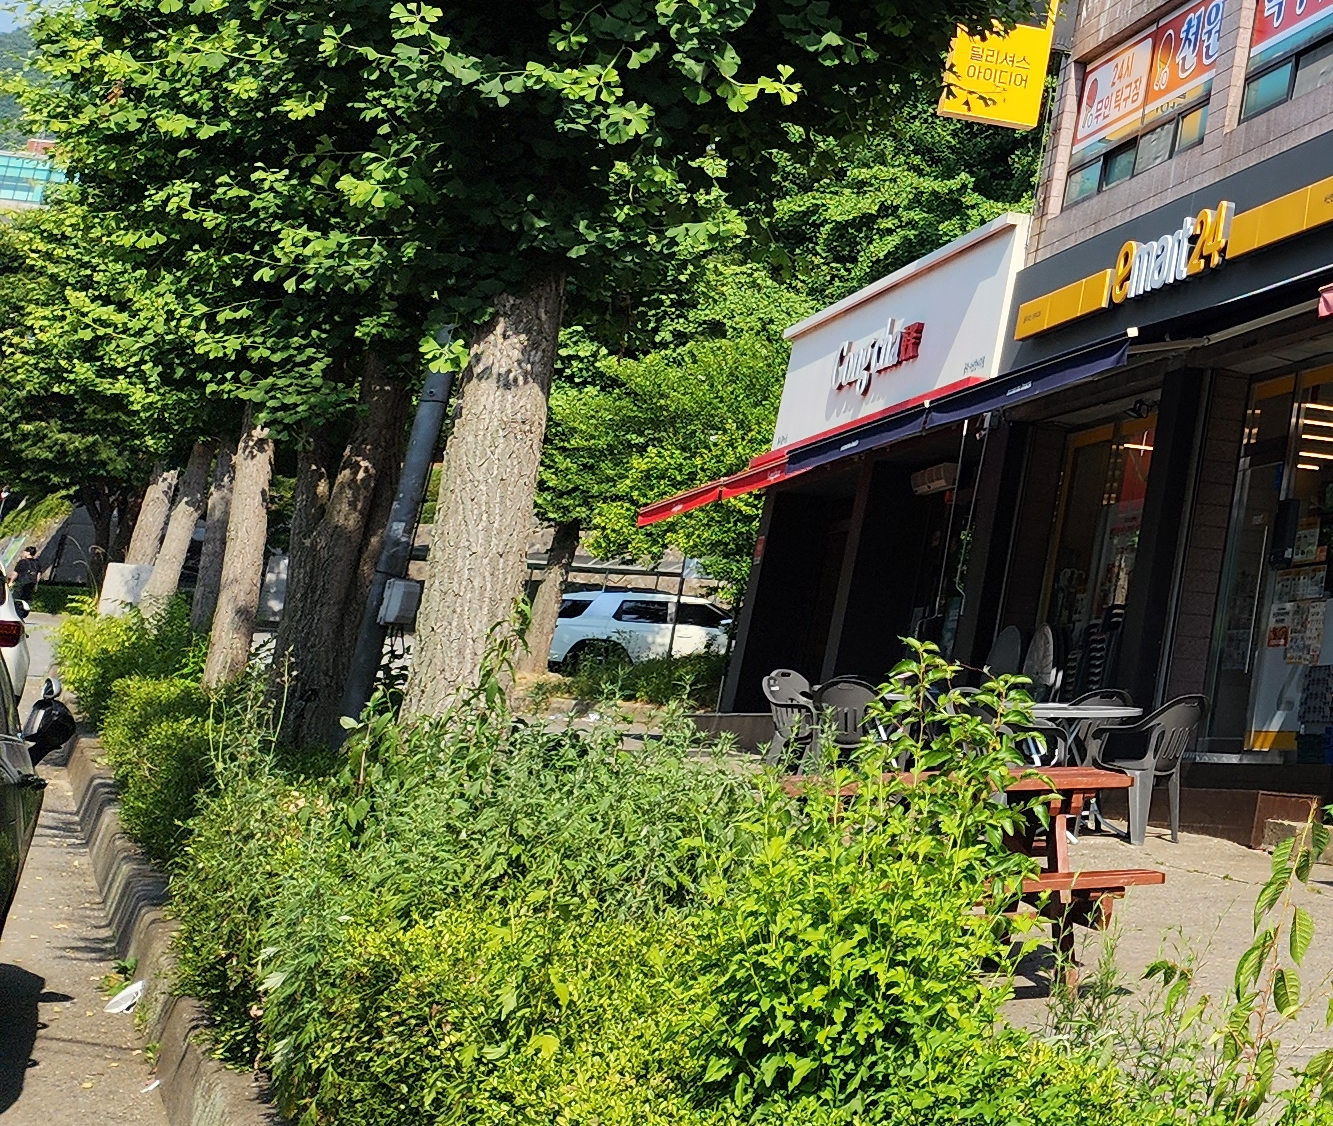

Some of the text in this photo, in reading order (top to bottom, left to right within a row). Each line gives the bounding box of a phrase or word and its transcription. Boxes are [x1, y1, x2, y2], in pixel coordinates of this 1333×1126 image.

[966, 64, 1029, 89] 아이디어
[969, 45, 1030, 71] 딜리셔스
[1110, 51, 1136, 88] 24시
[1093, 97, 1113, 124] 무인
[1113, 75, 1143, 112] 탁구장
[1112, 200, 1235, 304] emart24
